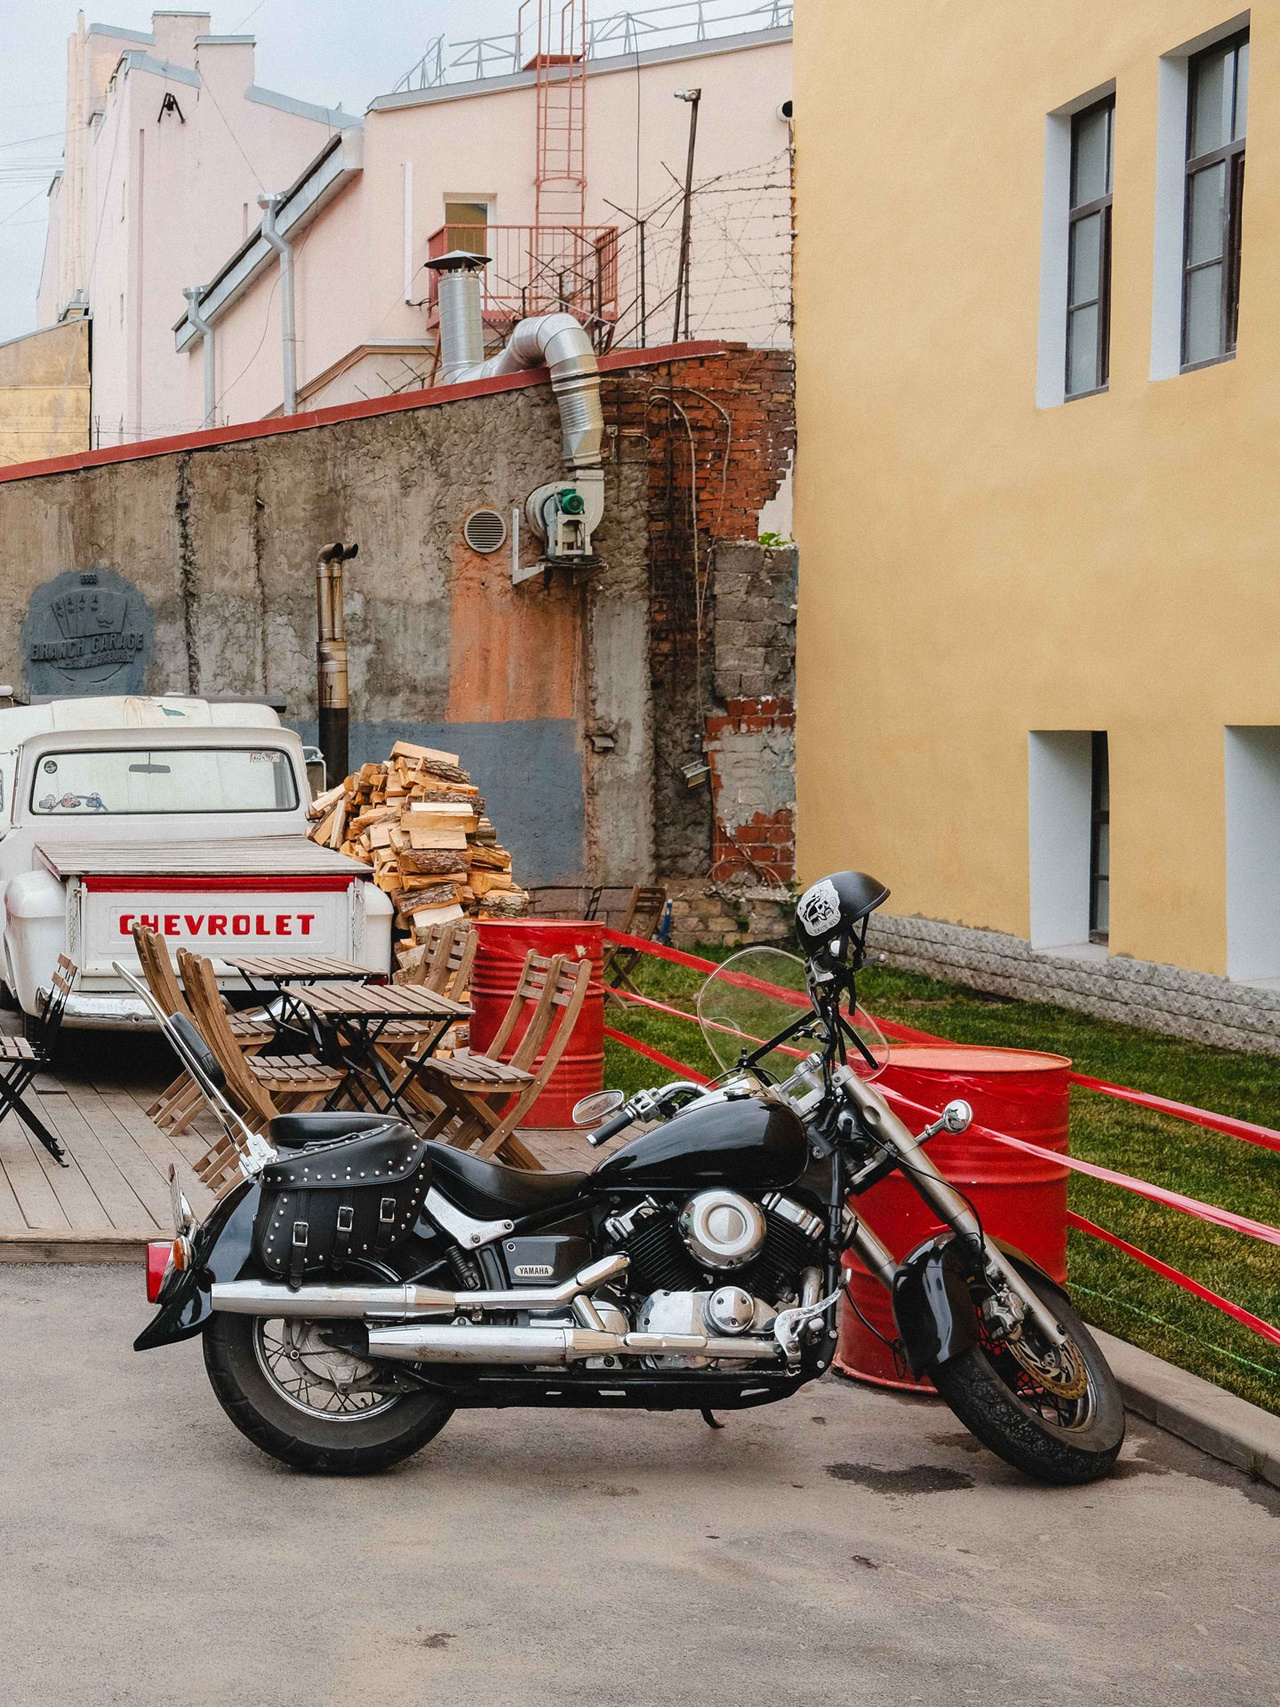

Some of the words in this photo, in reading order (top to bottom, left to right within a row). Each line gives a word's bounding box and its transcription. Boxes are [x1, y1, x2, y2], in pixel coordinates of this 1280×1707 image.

[30, 640, 85, 662] BRANCH
[91, 633, 144, 653] GARAGE
[119, 914, 315, 935] CHEVROLET
[519, 1267, 549, 1275] YAMAHA
